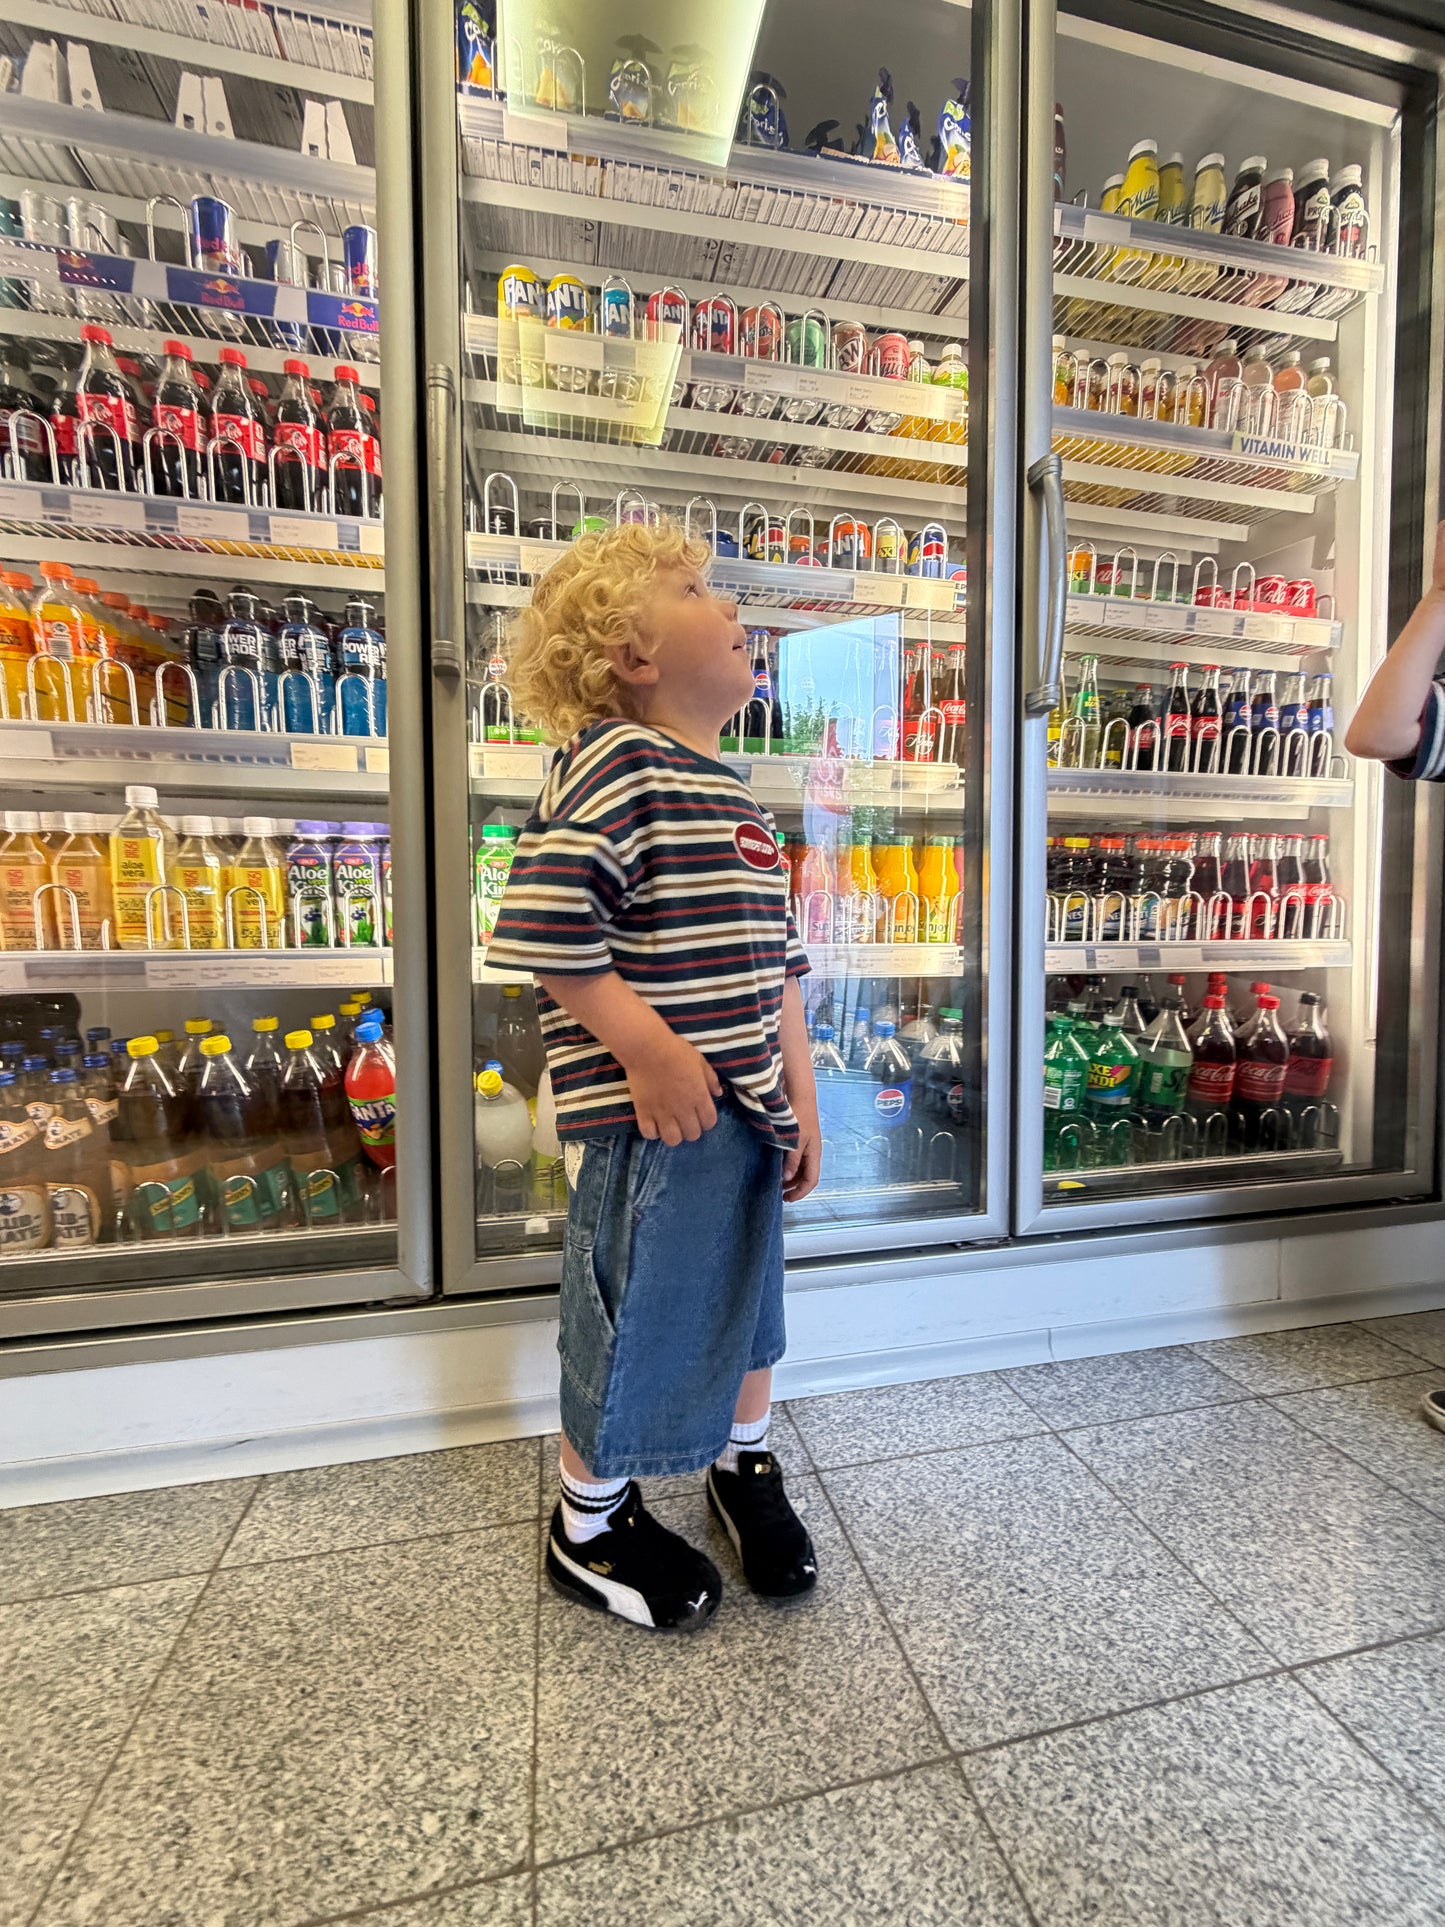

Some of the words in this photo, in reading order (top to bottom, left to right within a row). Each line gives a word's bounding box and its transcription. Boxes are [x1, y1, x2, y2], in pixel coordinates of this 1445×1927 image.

[503, 276, 542, 306] FAN
[338, 314, 358, 329] Red
[607, 303, 629, 325] AN
[1241, 437, 1296, 459] VITAMIN
[1300, 447, 1330, 465] WELL
[121, 861, 144, 870] aloe
[289, 865, 328, 880] Aloe
[336, 865, 373, 880] Aloe
[122, 870, 145, 878] vera
[481, 867, 508, 881] Alo
[482, 881, 505, 896] Kin
[812, 921, 830, 931] Sun
[876, 1098, 903, 1107] PEPSI
